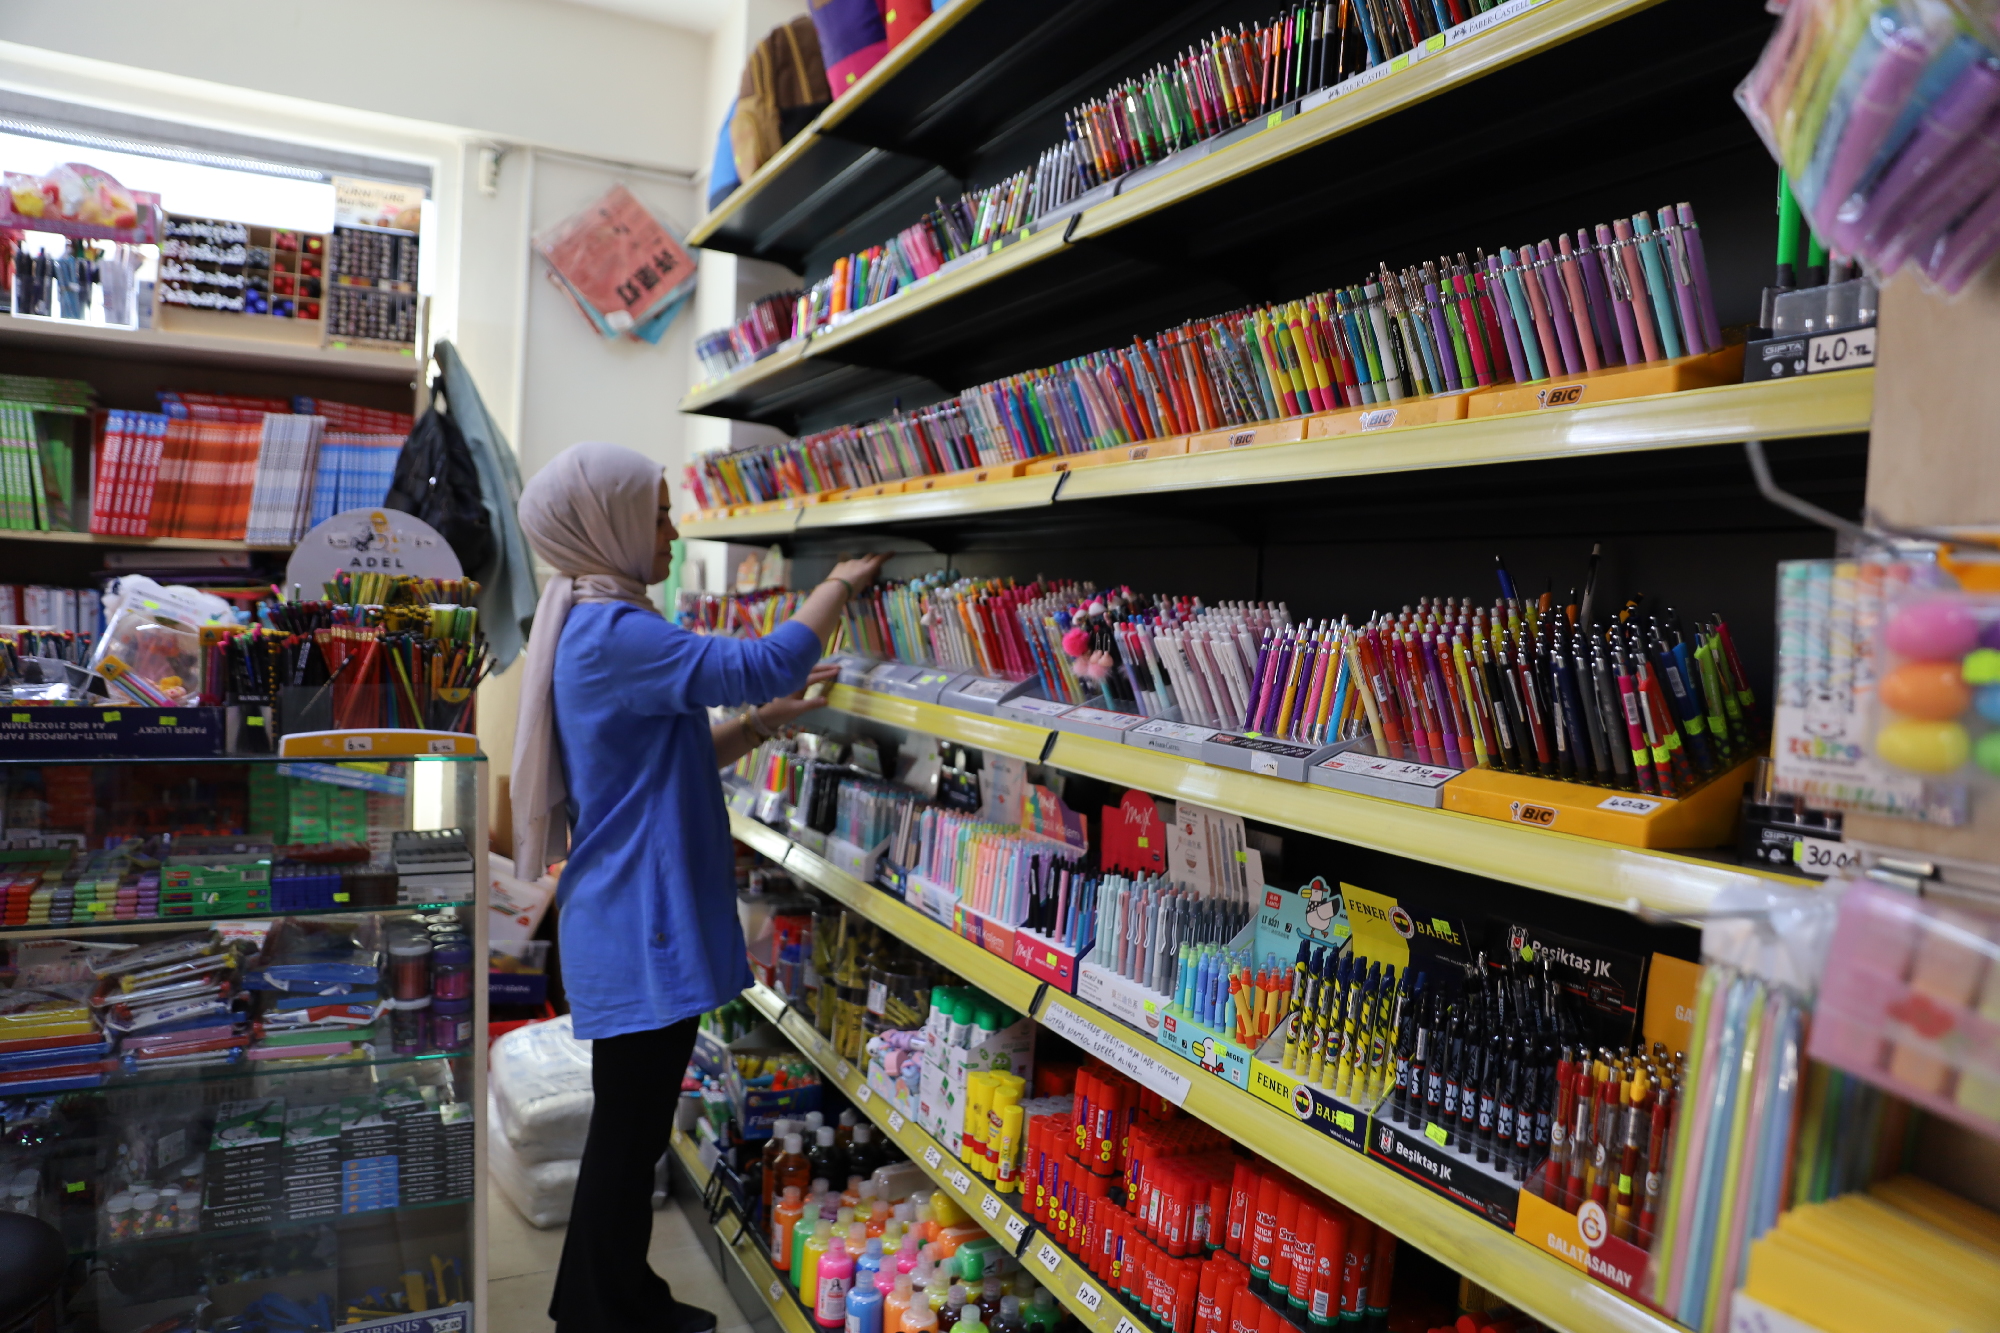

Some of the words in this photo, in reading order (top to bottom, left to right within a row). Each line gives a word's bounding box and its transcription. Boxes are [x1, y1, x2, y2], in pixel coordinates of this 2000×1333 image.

[350, 557, 404, 568] ADEL
[1349, 899, 1387, 921] FENER
[1257, 1072, 1289, 1099] FENER
[1396, 1141, 1438, 1174] Beşiktaş
[1439, 1163, 1452, 1181] JK
[1547, 1232, 1633, 1288] GALATASARAY
[351, 1320, 421, 1333] BENIS
